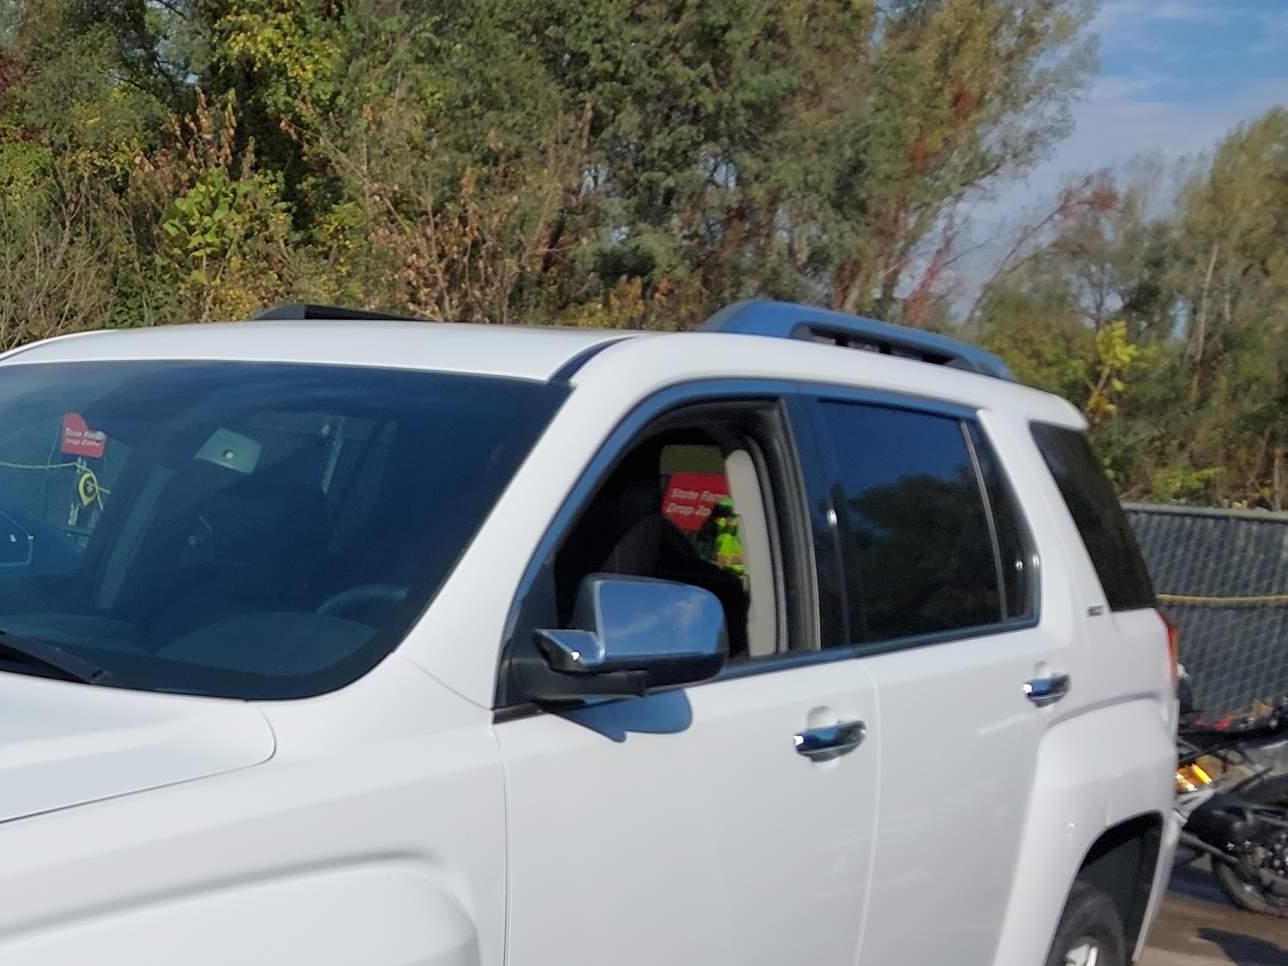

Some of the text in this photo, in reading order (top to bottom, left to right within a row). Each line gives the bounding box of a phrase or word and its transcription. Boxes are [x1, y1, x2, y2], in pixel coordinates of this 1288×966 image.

[670, 488, 699, 500] State
[666, 502, 712, 516] Drop Zo
